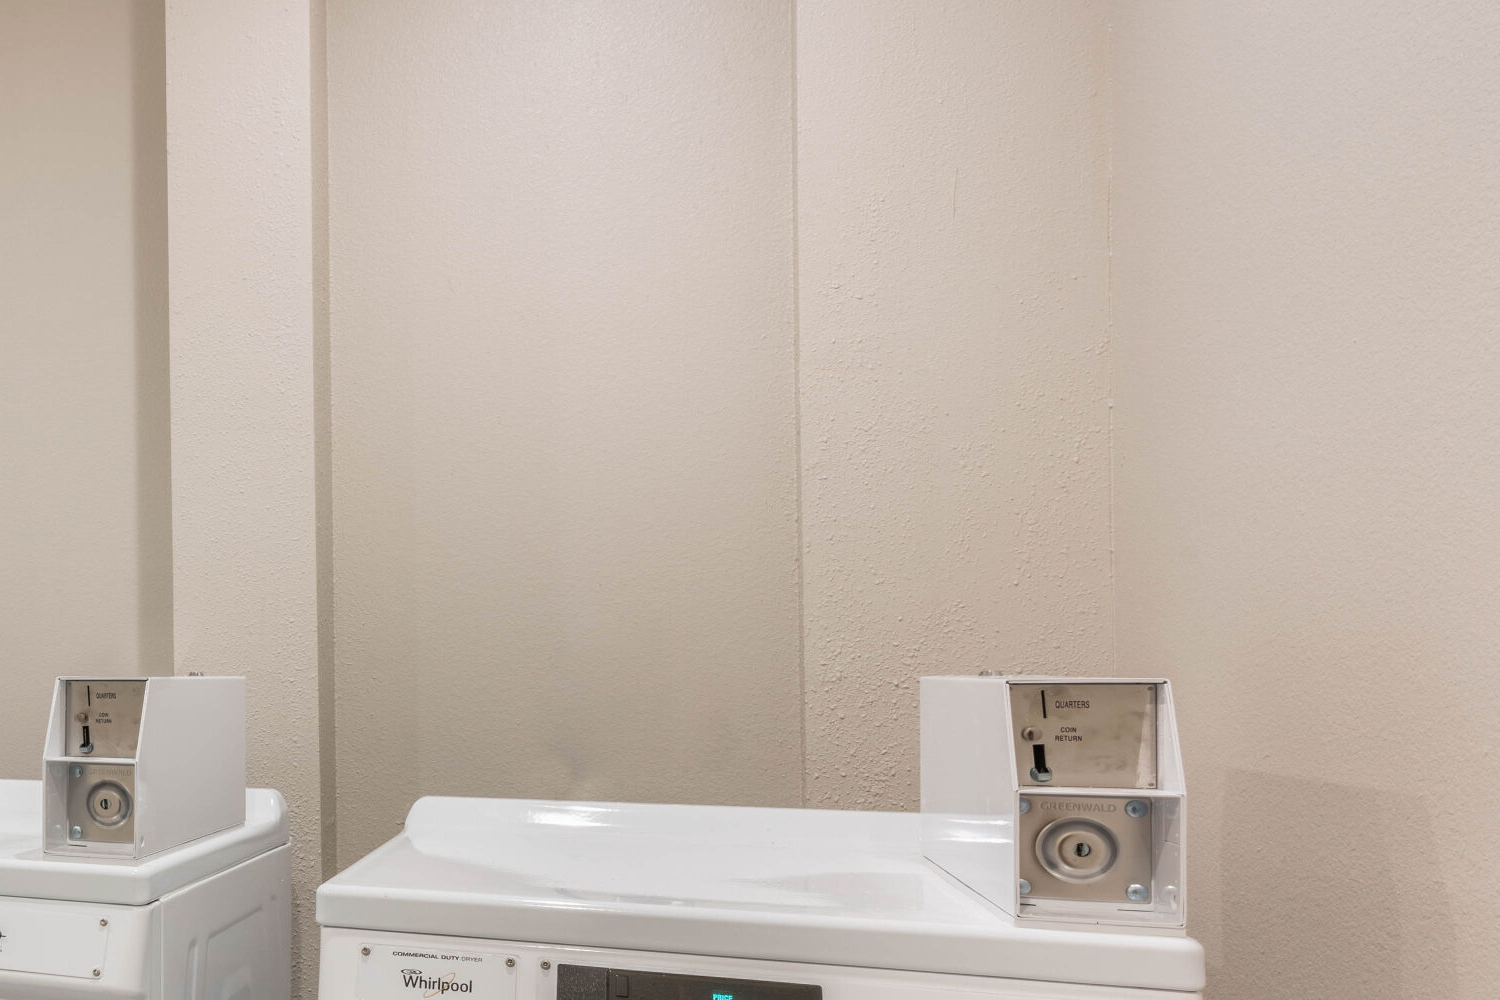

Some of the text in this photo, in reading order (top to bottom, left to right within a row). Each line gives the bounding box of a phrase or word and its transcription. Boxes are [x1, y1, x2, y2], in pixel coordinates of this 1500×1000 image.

[1055, 700, 1091, 709] QUARTERS
[1040, 801, 1117, 813] GREENWALD
[392, 951, 440, 960] COMMERCIAL
[402, 974, 474, 995] Whirlpool
